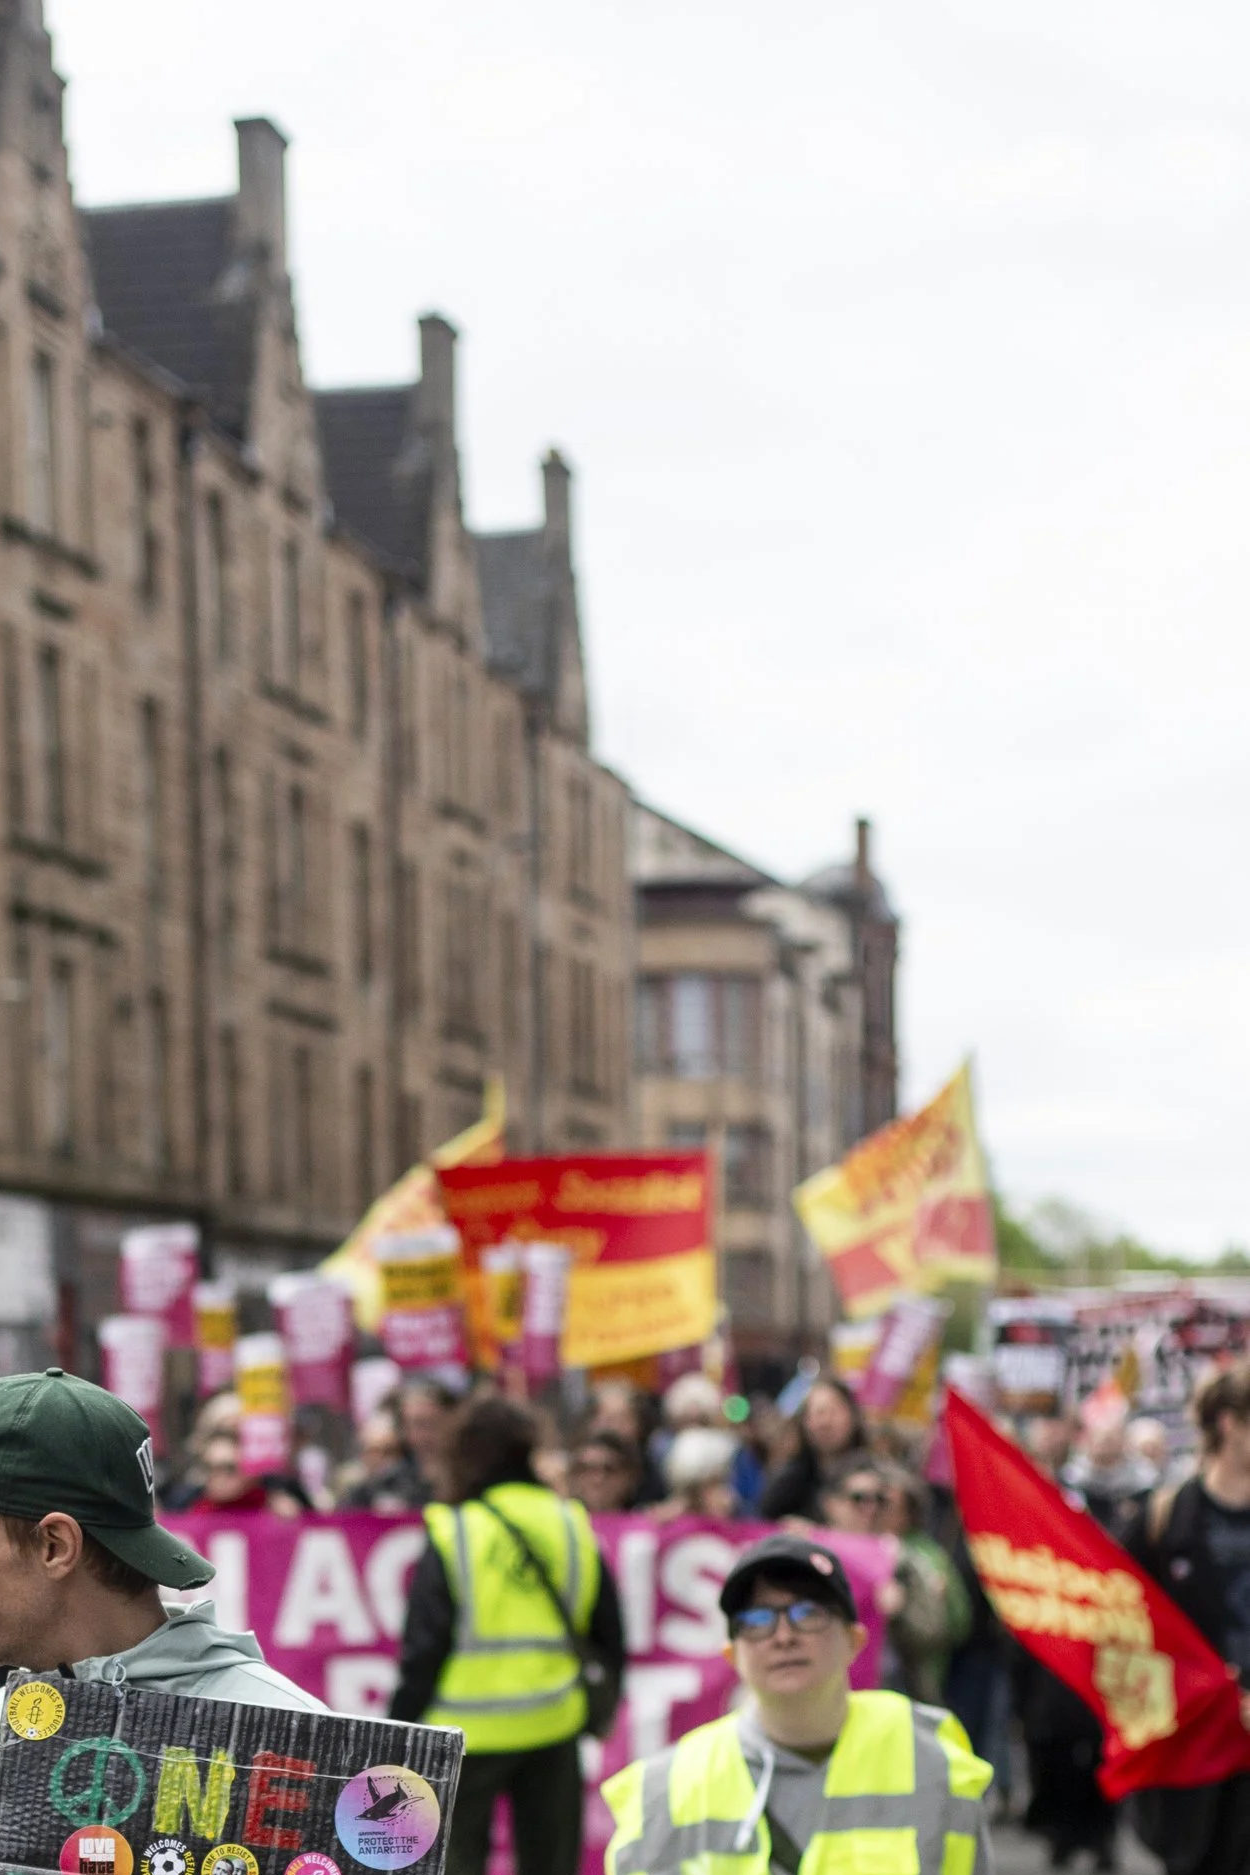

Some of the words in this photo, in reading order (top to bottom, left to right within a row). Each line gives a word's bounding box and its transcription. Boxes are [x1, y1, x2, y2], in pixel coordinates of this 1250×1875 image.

[18, 1684, 61, 1703] WELCOMES
[10, 1697, 28, 1734] FOOTBALL
[38, 1703, 64, 1737] REFUGEES
[144, 1839, 187, 1858] WELCOMES
[358, 1837, 399, 1846] PROTECT
[400, 1836, 419, 1845] THE
[358, 1845, 413, 1855] ANTARCTIC
[203, 1854, 217, 1871] TIME
[216, 1847, 225, 1856] TO
[226, 1846, 251, 1860] RESIST
